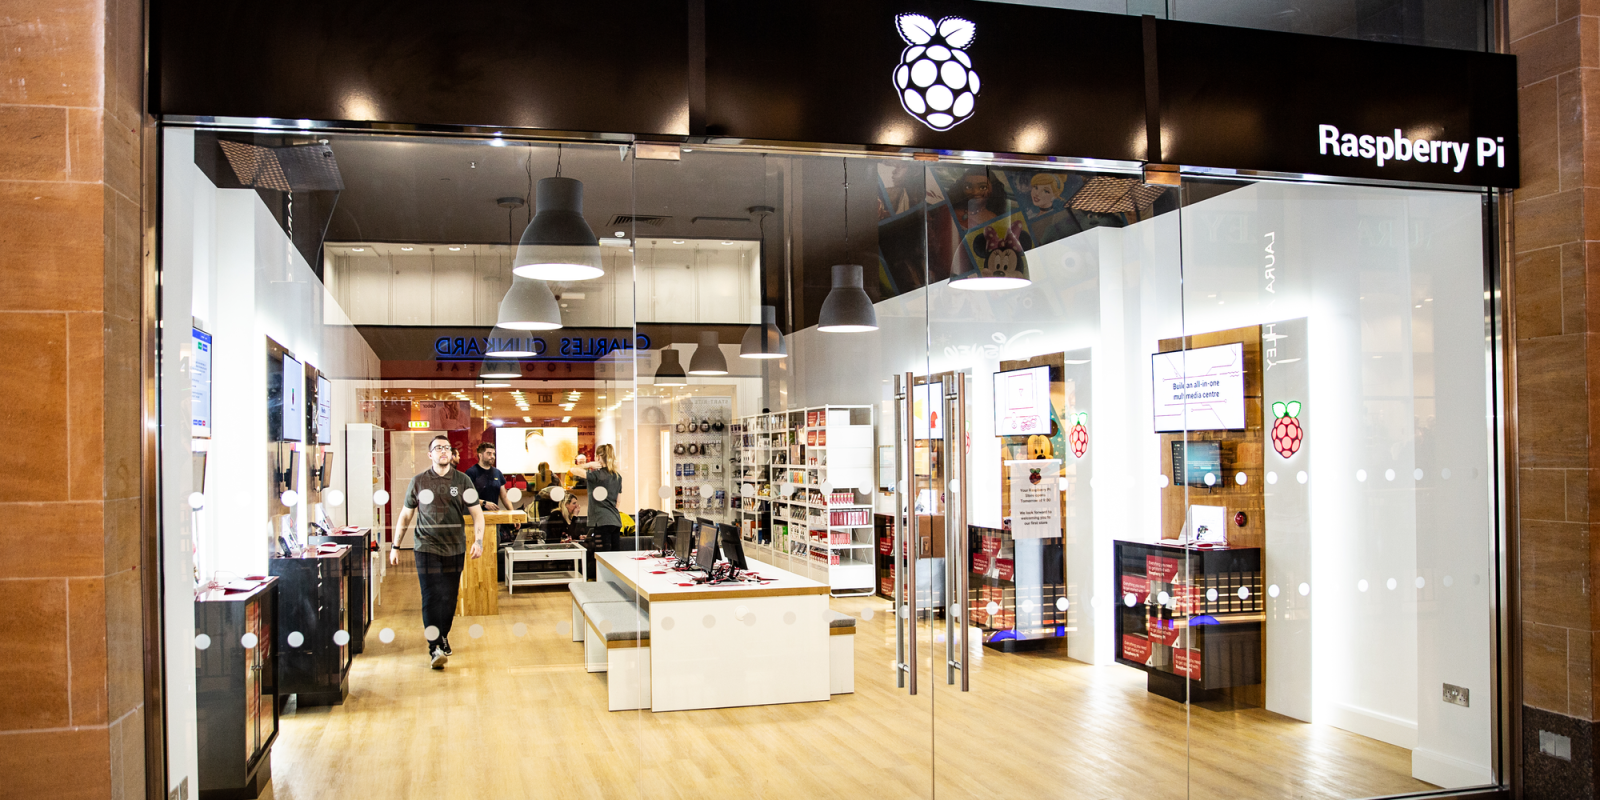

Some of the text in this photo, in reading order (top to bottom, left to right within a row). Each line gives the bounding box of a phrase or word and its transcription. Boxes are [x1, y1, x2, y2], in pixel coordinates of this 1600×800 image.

[1318, 124, 1505, 172] Raspberry Pi
[1194, 380, 1220, 388] all-in-one
